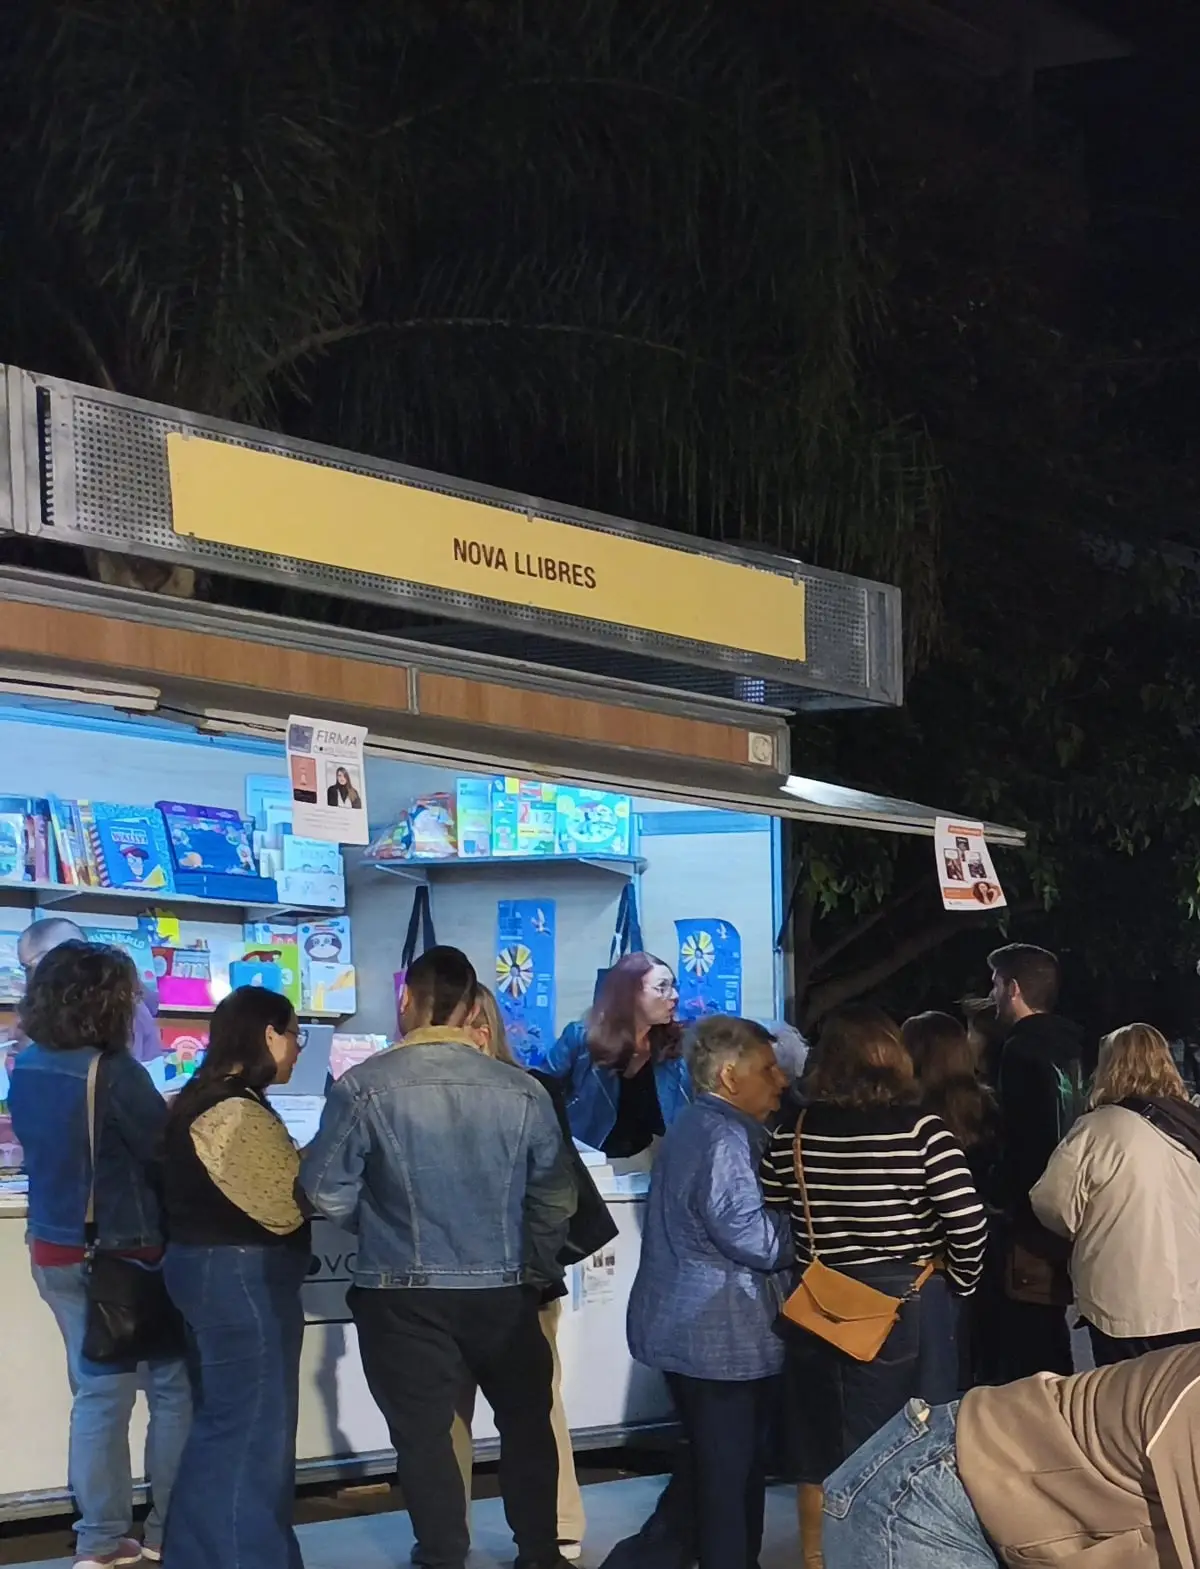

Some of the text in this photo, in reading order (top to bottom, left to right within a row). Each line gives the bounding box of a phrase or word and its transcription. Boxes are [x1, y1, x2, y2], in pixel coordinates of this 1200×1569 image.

[453, 537, 597, 589] NOVA LLIBRES
[316, 729, 358, 747] FIRMA
